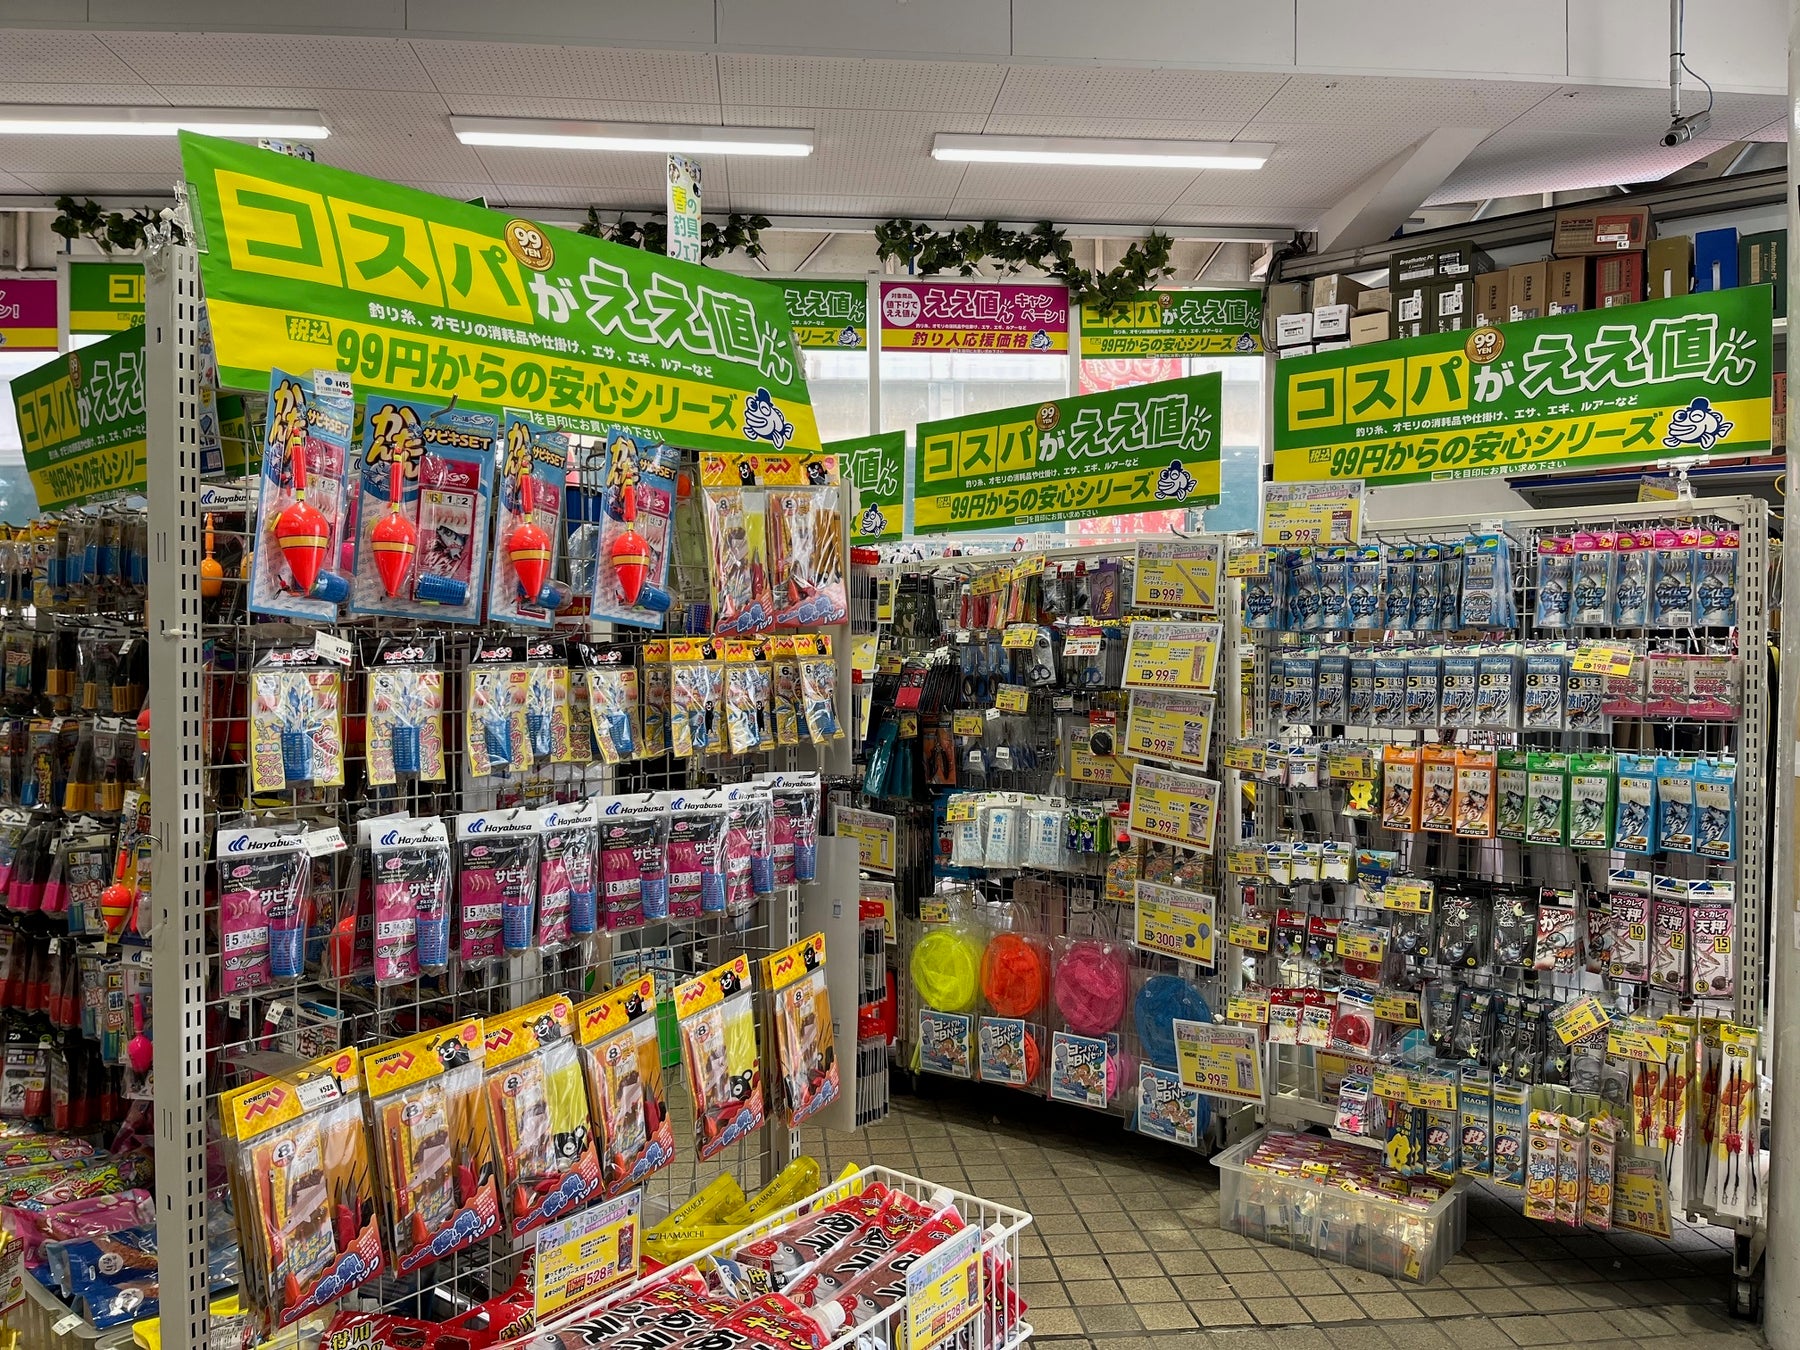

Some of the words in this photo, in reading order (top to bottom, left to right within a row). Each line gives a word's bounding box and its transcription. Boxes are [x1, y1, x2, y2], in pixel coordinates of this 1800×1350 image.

[672, 186, 697, 214] 春の
[674, 215, 698, 240] 釣具
[514, 226, 542, 248] 99
[521, 247, 542, 260] YEN
[674, 239, 699, 262] フェア
[220, 180, 793, 386] コスパがええ値ん
[886, 301, 918, 309] 値下げて
[923, 288, 1014, 324] ええ値ん
[1015, 293, 1053, 309] キャン
[887, 309, 917, 318] ええ値ん
[369, 301, 714, 379] 釣り糸、オモリの消耗品や仕掛け、エサ、エギ、ルアーなど
[911, 331, 1029, 348] 釣り人応援価格
[1101, 337, 1234, 353] 99円からの安心シリーズ
[1474, 333, 1497, 348] 99
[1476, 346, 1493, 355] YEN
[287, 316, 333, 345] 税込
[337, 329, 738, 432] 99円からの安心シリーズ
[1292, 313, 1756, 428] コスパがええ値ん
[335, 380, 351, 389] ¥495
[1041, 406, 1056, 418] 99
[1356, 394, 1639, 437] 釣り糸、オモリの消耗品や仕掛け、エサ、エギ、ルアーなど
[308, 409, 350, 438] サビキSET
[423, 427, 493, 450] サビキSET
[927, 393, 1211, 478] コスパがええ値ん
[1310, 448, 1332, 464] 税込
[1330, 411, 1665, 475] 99円からの安心シリーズ
[532, 446, 566, 469] サビキSET
[1454, 459, 1567, 479] を目印にお買い求め下さい
[951, 472, 1154, 520] 99円からの安心シリーズ
[755, 616, 773, 632] パック
[824, 609, 845, 624] パック
[1271, 675, 1279, 685] 4
[1285, 677, 1295, 688] 5
[1320, 674, 1328, 684] 5
[1351, 678, 1359, 688] 5
[1375, 678, 1385, 688] 5
[1408, 676, 1418, 687] 5
[1444, 677, 1455, 687] 8
[1480, 675, 1491, 686] 8
[1527, 675, 1538, 686] 8
[1569, 678, 1580, 690] 8
[621, 804, 665, 815] Hayabusa
[684, 801, 723, 811] Hayabusa
[485, 822, 533, 834] Hayabusa
[558, 816, 592, 827] Hayabusa
[398, 833, 445, 846] Hayabusa
[633, 845, 662, 860] サビキ
[495, 869, 528, 884] サビキ
[408, 882, 442, 898] サビキ
[1611, 907, 1643, 922] 天秤
[1656, 913, 1683, 931] 天秤
[1632, 926, 1643, 935] 10
[1694, 919, 1727, 934] 天秤
[1673, 935, 1683, 944] 12
[1716, 938, 1728, 948] 15
[939, 1026, 966, 1041] BNセット
[997, 1029, 1022, 1045] BNセット
[1075, 1050, 1104, 1068] BNセット
[1496, 1106, 1520, 1114] NAGE
[575, 1178, 598, 1203] パック
[754, 1183, 782, 1209] HAMAICHI
[468, 1216, 495, 1241] パック
[659, 1230, 705, 1239] HAMAICHI
[351, 1256, 378, 1288] パック
